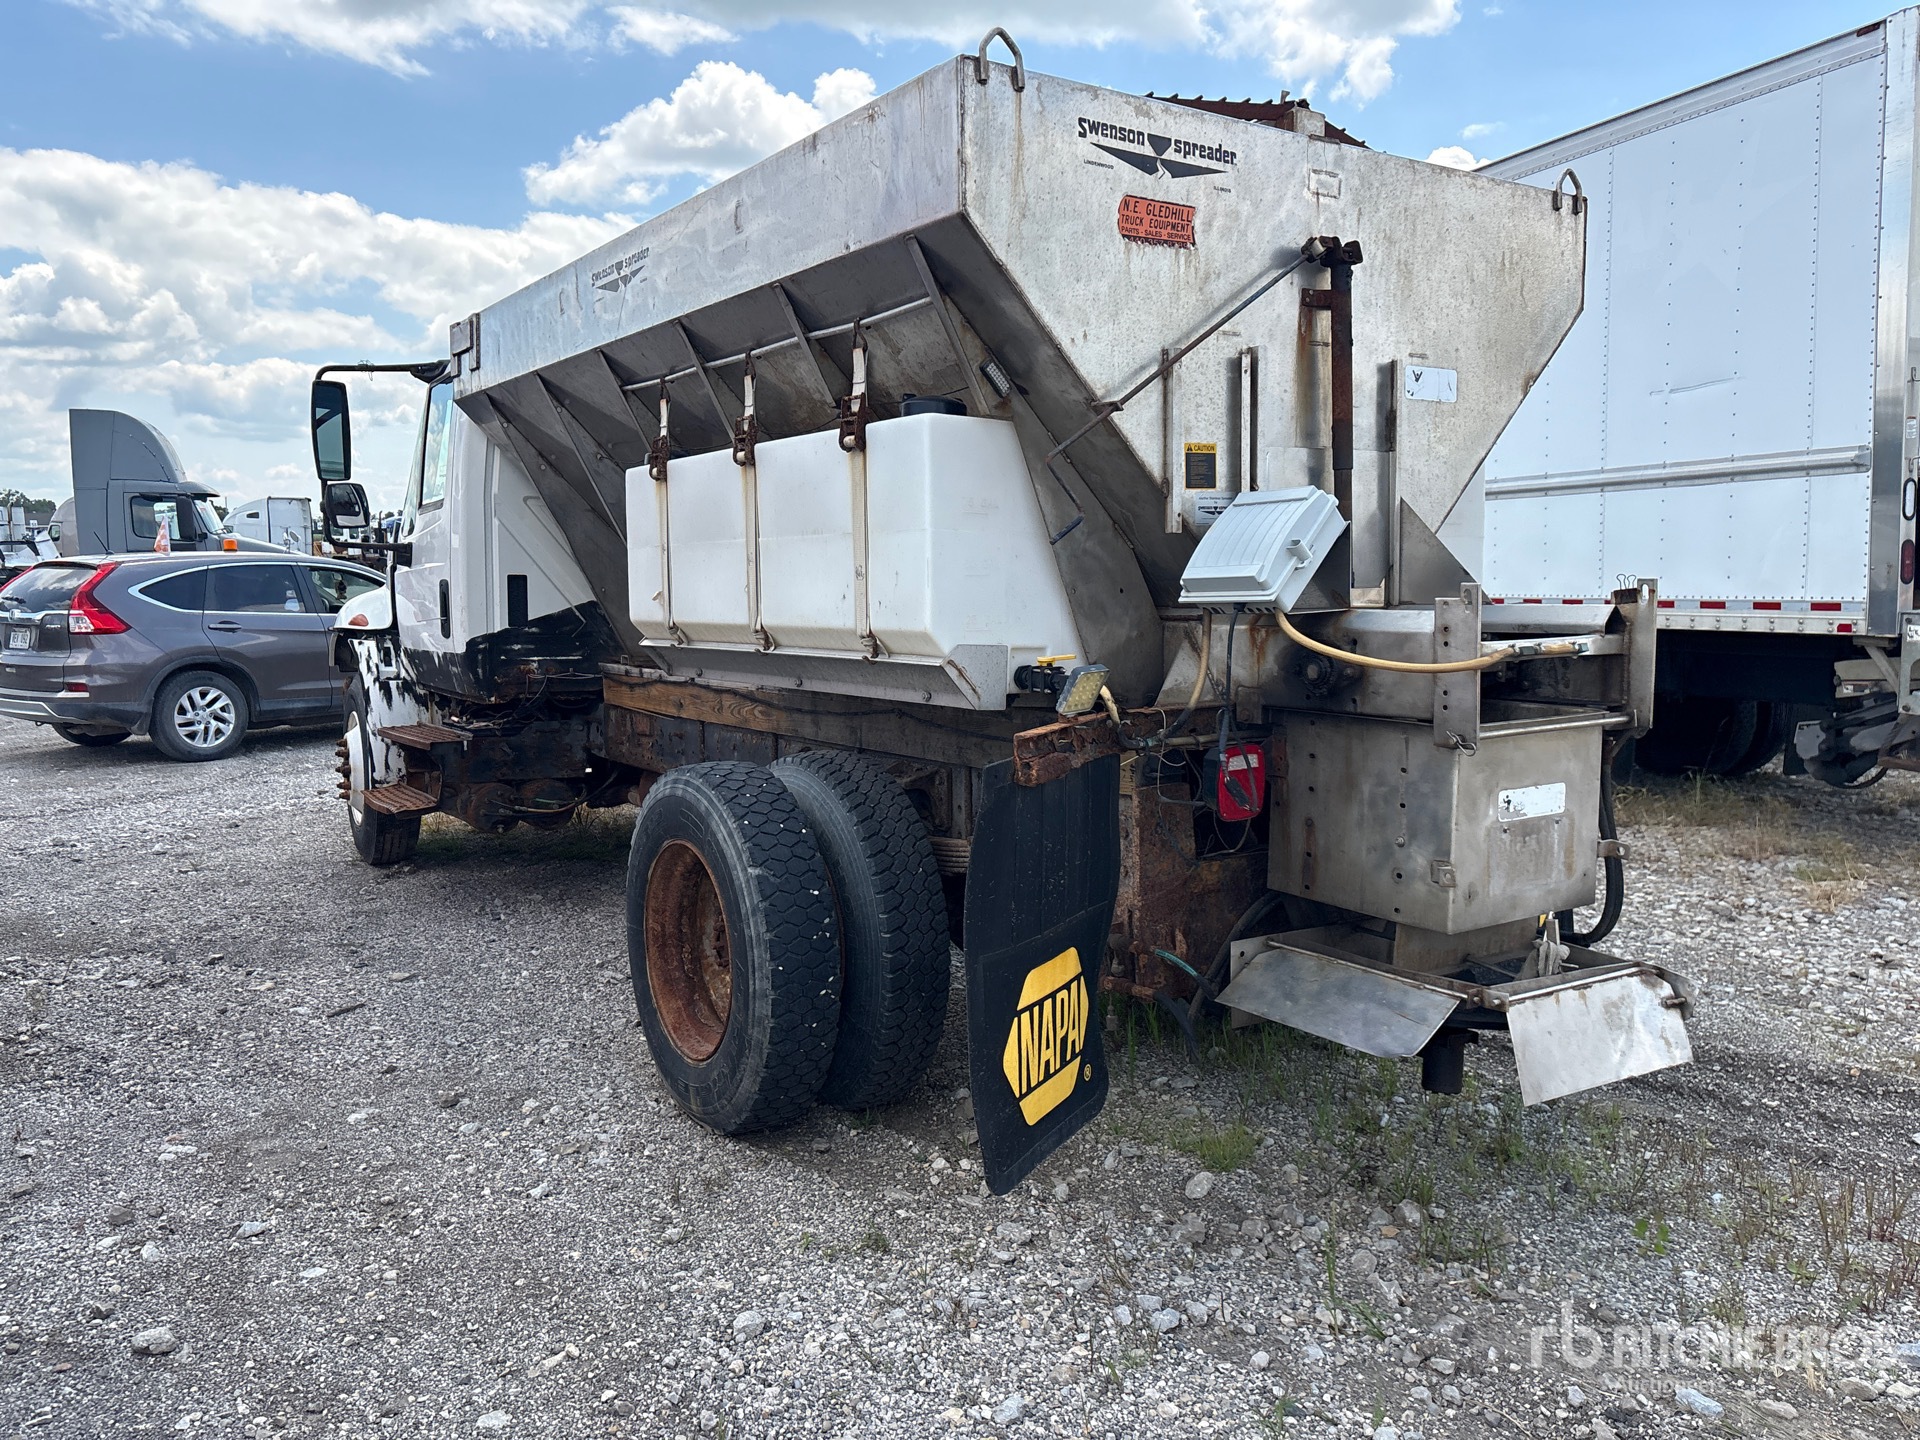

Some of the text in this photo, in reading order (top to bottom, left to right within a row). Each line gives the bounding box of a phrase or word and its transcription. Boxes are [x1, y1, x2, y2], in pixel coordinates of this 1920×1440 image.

[1077, 116, 1237, 166] Swenson spreader
[1123, 198, 1192, 223] N.E. GLEDHILL
[1121, 213, 1191, 233] TRUCK EQUIPMENT
[1121, 225, 1140, 235] PARTS
[1144, 229, 1163, 238] SALES
[1166, 231, 1191, 241] SERVICE
[1193, 444, 1215, 452] CAUTION
[1020, 979, 1079, 1094] NAPA
